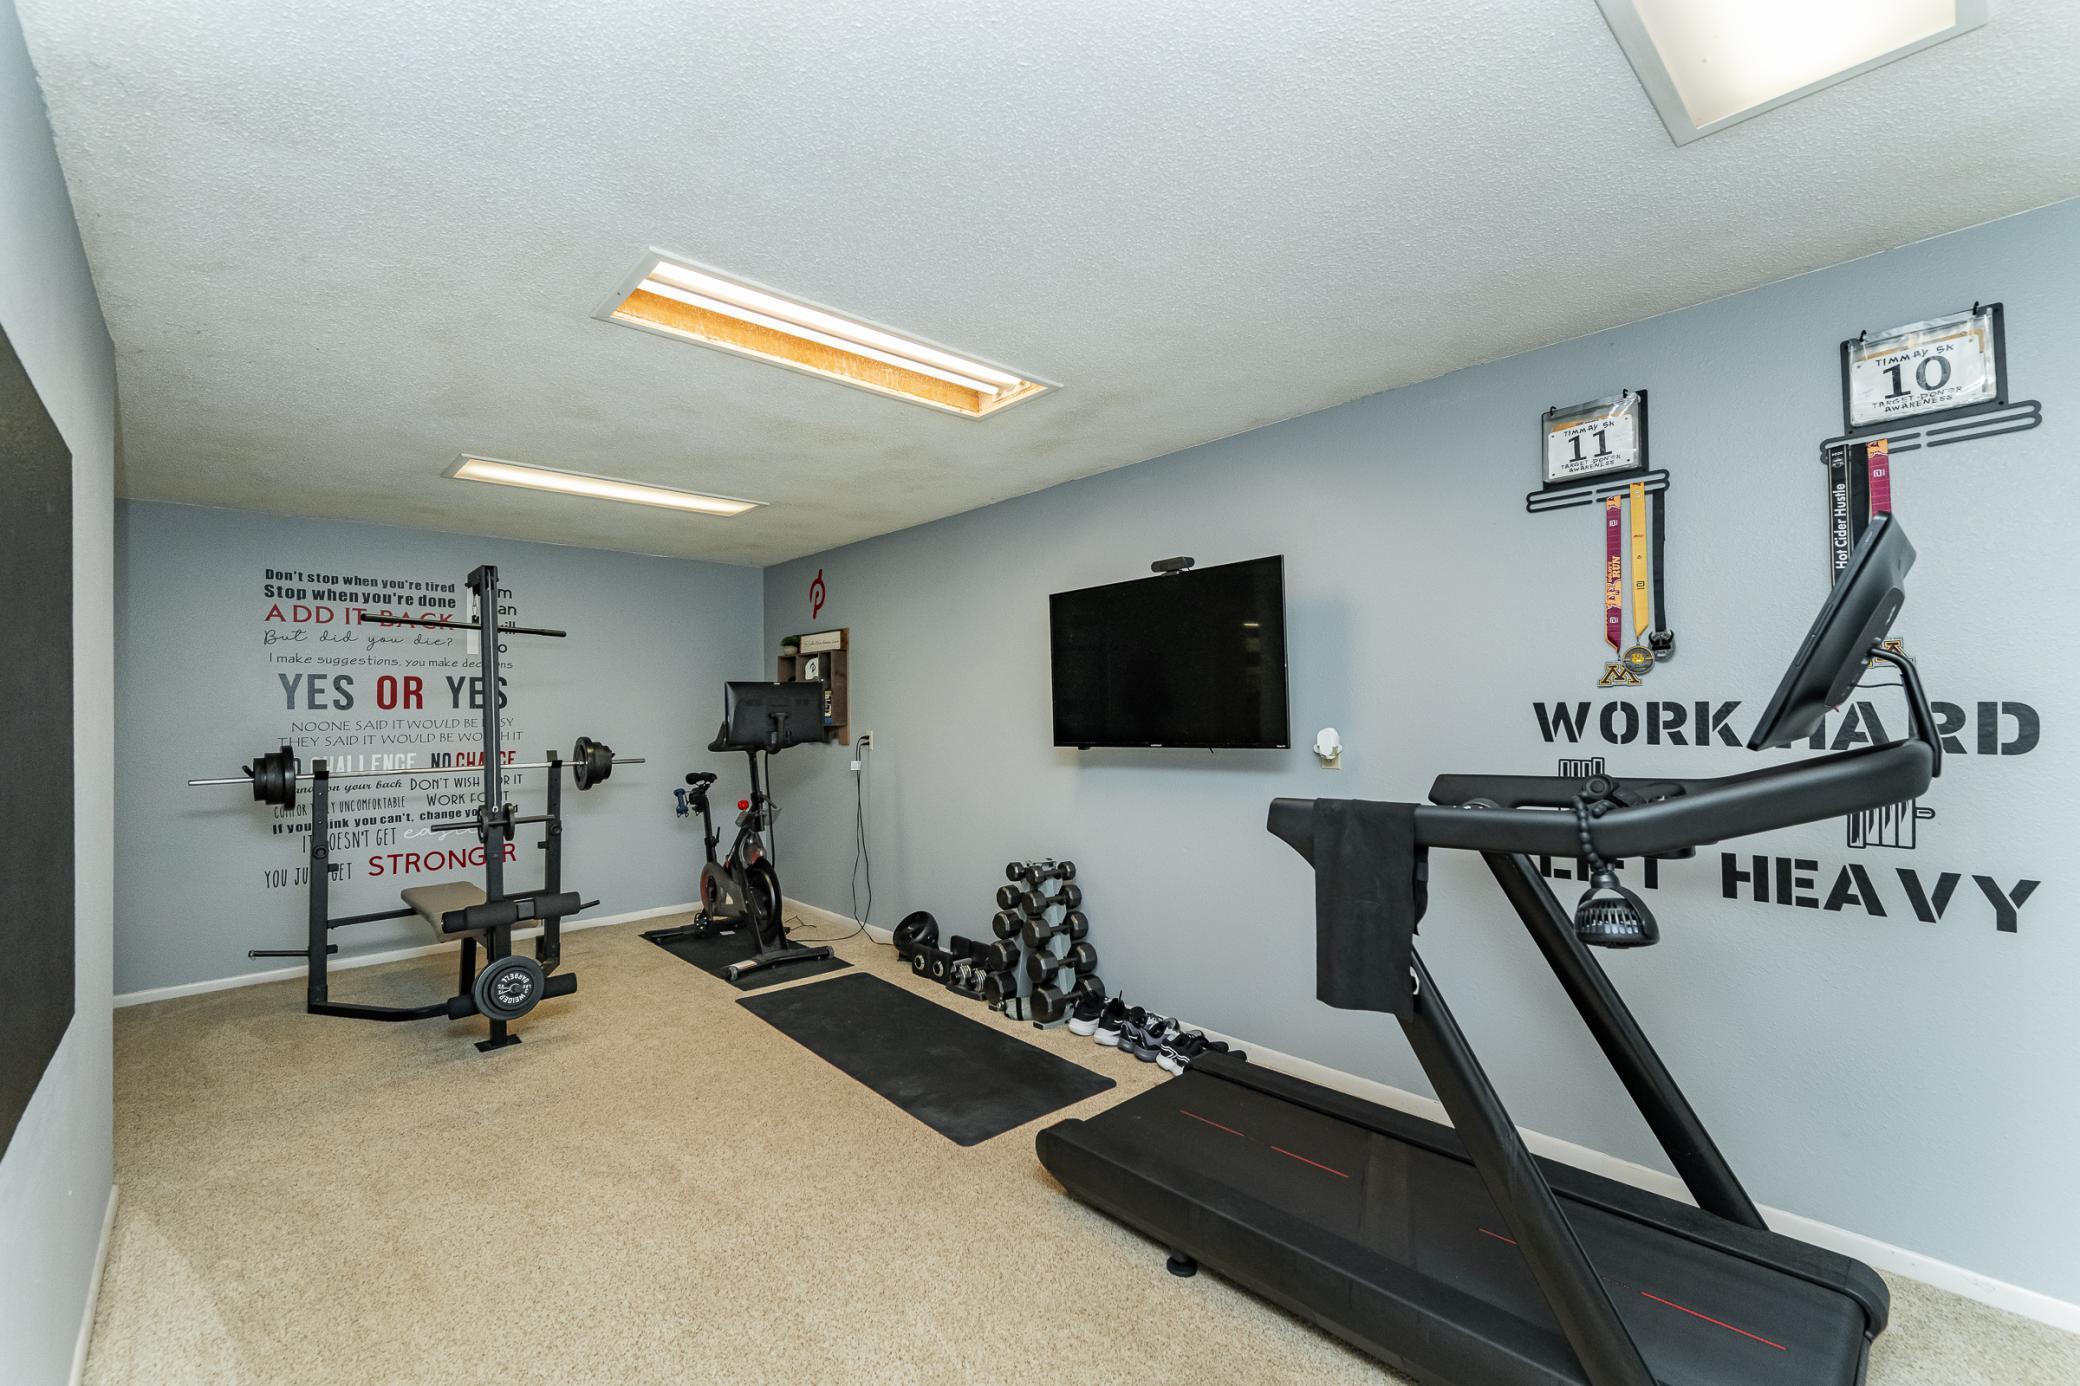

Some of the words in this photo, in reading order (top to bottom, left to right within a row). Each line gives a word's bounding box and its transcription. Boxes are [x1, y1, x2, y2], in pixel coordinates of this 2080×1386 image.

[1875, 349, 1928, 366] TIMMAY
[1883, 355, 1951, 399] 10
[1885, 395, 1953, 412] AWARENESS
[1564, 424, 1598, 437] TIMMAY
[1568, 430, 1612, 462] 11
[1569, 460, 1615, 472] AWARENESS
[1832, 483, 1846, 517] Hustle
[1834, 519, 1848, 548] Cider
[1612, 555, 1621, 578] RUN
[1835, 550, 1848, 569] Hot
[265, 569, 303, 581] Don't
[307, 572, 338, 585] stop
[343, 576, 378, 587] when
[382, 579, 422, 591] you're
[425, 581, 455, 593] tired
[264, 584, 307, 600] Stop
[312, 588, 359, 603] when
[362, 591, 414, 606] you're
[418, 594, 456, 609] done
[264, 603, 334, 624] ADD
[345, 607, 367, 626] IT
[264, 629, 308, 645] But
[320, 630, 359, 642] did
[366, 636, 405, 651] you
[413, 634, 453, 646] die?
[269, 652, 273, 662] I
[276, 653, 312, 664] make
[405, 658, 425, 667] you
[428, 657, 458, 667] make
[278, 673, 354, 710] YES
[377, 675, 423, 710] OR
[355, 720, 388, 730] SAID
[392, 720, 406, 730] IT
[407, 719, 460, 730] WOULD
[464, 719, 478, 729] BE
[1532, 700, 1743, 747] WORK
[277, 736, 320, 747] THEY
[325, 735, 359, 747] SAID
[363, 735, 376, 745] IT
[381, 733, 435, 744] WOULD
[440, 732, 454, 743] BE
[513, 731, 524, 741] IT
[431, 752, 451, 768] NO
[345, 784, 372, 793] your
[375, 779, 403, 789] back
[410, 777, 449, 791] DON'T
[454, 776, 480, 788] WISH
[514, 774, 523, 784] IT
[340, 796, 405, 813] UNCOMFORTABLE
[426, 793, 466, 807] WORK
[273, 823, 282, 835] If
[287, 823, 312, 834] you
[354, 816, 377, 827] you
[420, 809, 462, 821] change
[376, 827, 397, 846] GET
[264, 868, 288, 888] YOU
[368, 843, 517, 876] STRONGR
[1721, 852, 2040, 933] HEAVY
[499, 993, 526, 1004] WEIDER
